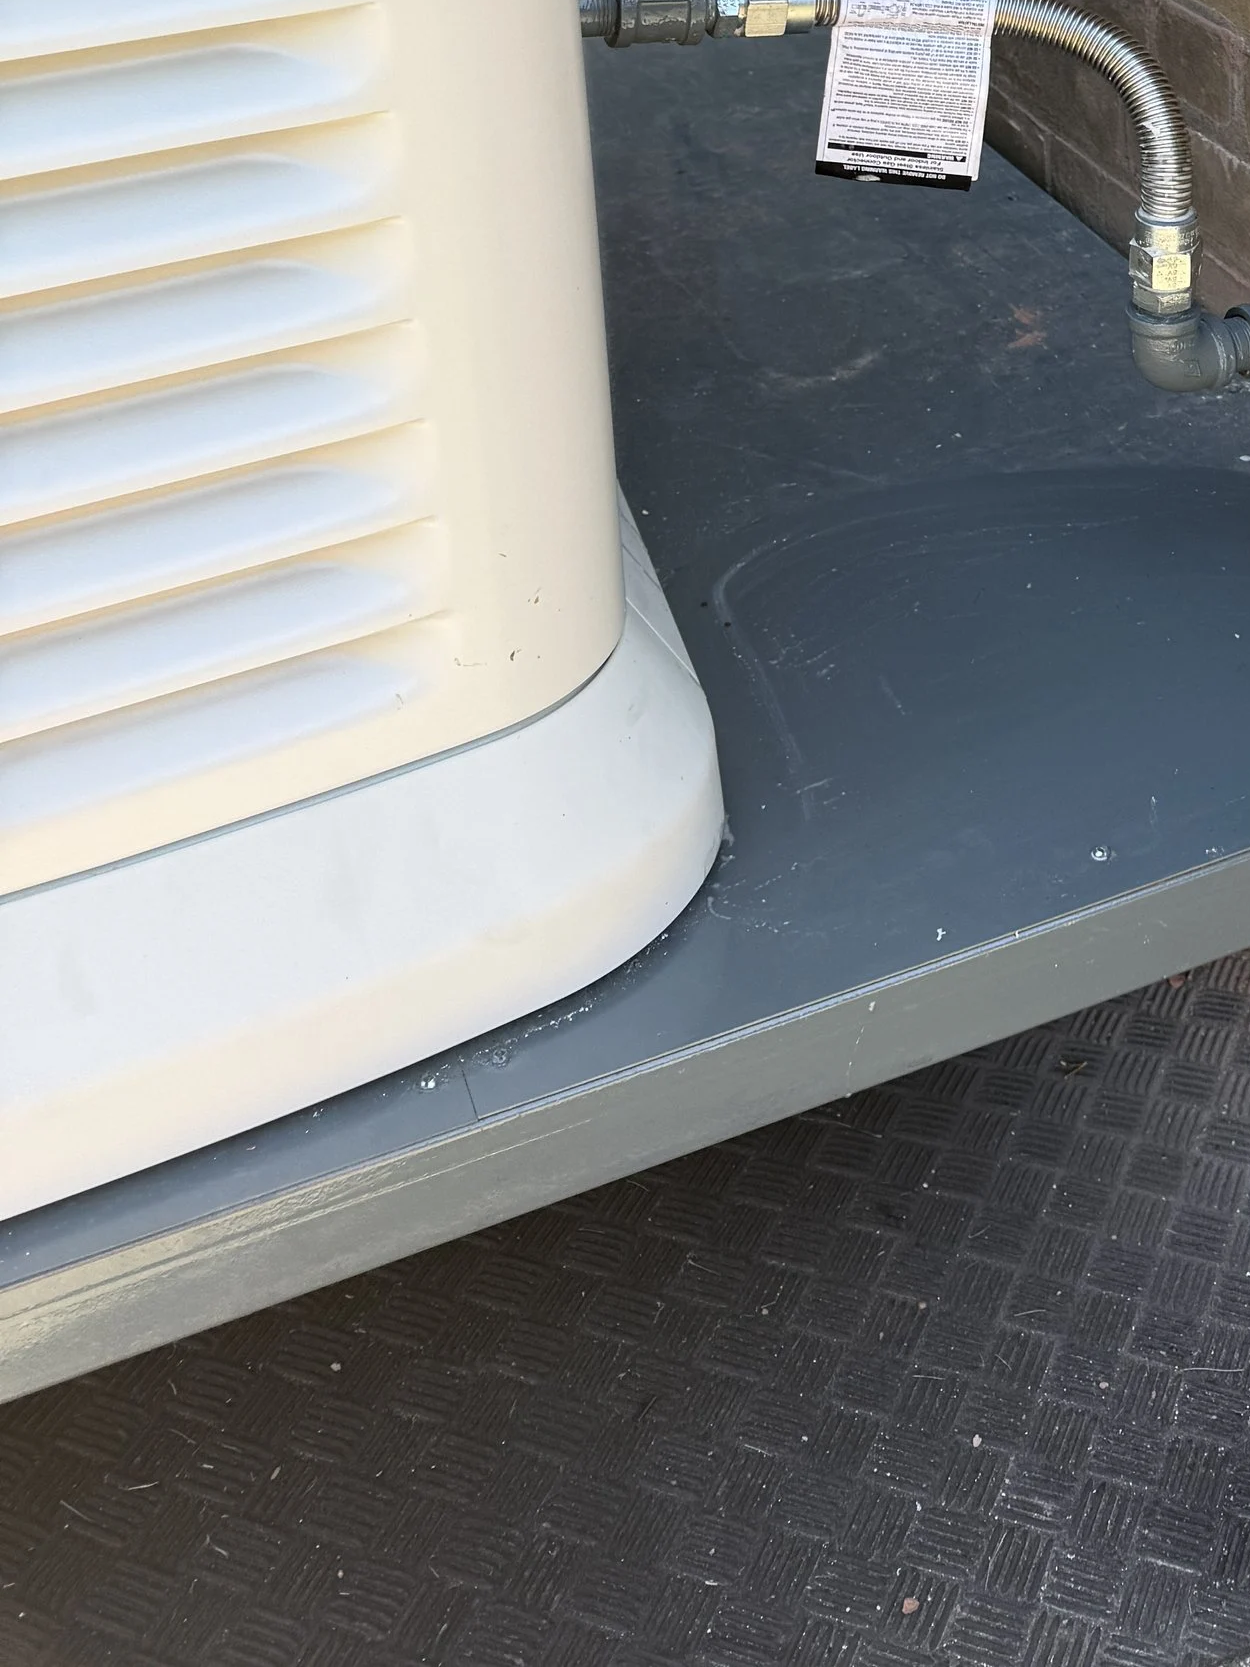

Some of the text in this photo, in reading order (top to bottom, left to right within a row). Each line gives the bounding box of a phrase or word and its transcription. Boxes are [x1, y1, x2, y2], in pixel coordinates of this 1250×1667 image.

[866, 152, 893, 161] Outdoor
[846, 157, 881, 166] Connector
[843, 163, 861, 171] LABEL
[860, 165, 888, 174] WARNING
[915, 164, 944, 172] Stainless
[902, 170, 925, 178] REMOVE
